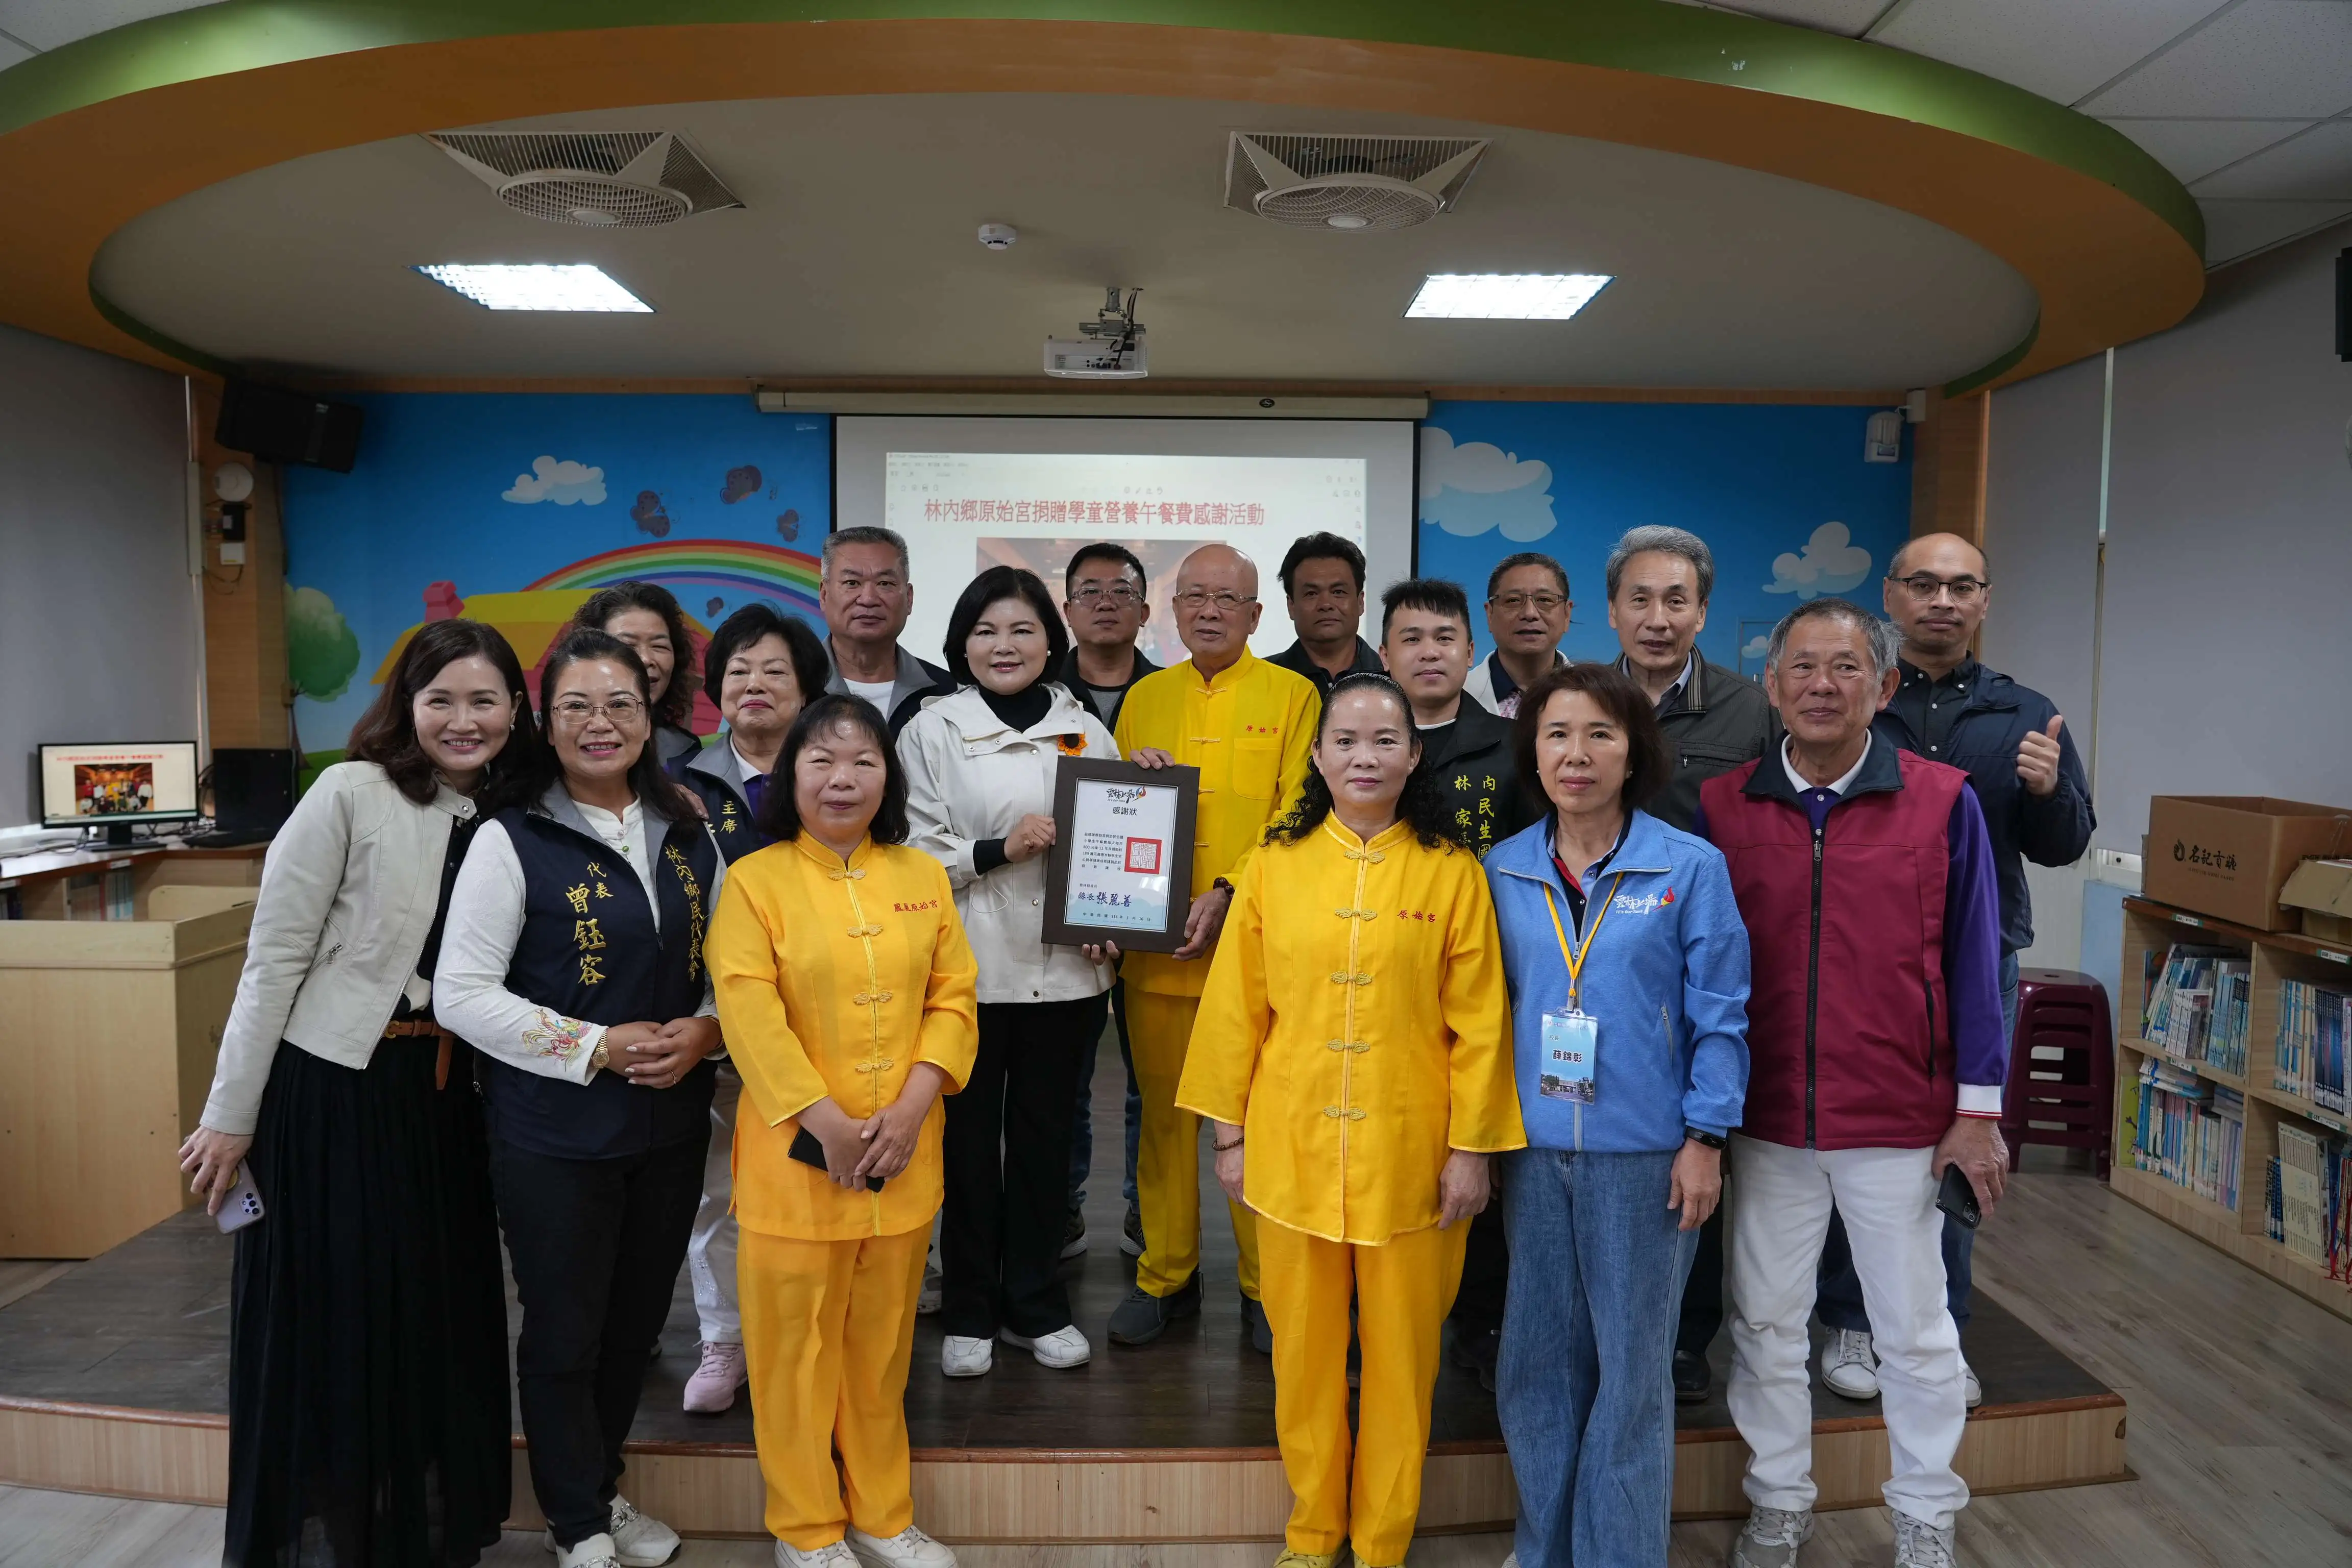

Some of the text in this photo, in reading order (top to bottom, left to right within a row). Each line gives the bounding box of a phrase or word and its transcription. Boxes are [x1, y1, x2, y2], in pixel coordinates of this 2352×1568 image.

[924, 498, 1264, 526] 林內鄉原始宮捐贈學童營養午餐費感謝活動
[1246, 725, 1279, 734] 原始宮
[720, 800, 738, 835] 主席
[1113, 806, 1137, 816] 感謝狀
[2189, 845, 2237, 871] 名記貢糖
[587, 862, 614, 899] 代表
[665, 844, 712, 983] 林內鄉民代表會
[1397, 910, 1436, 923] 原始宮
[566, 883, 606, 986] 曾鈺容
[1553, 1049, 1582, 1063] 薛錦彰
